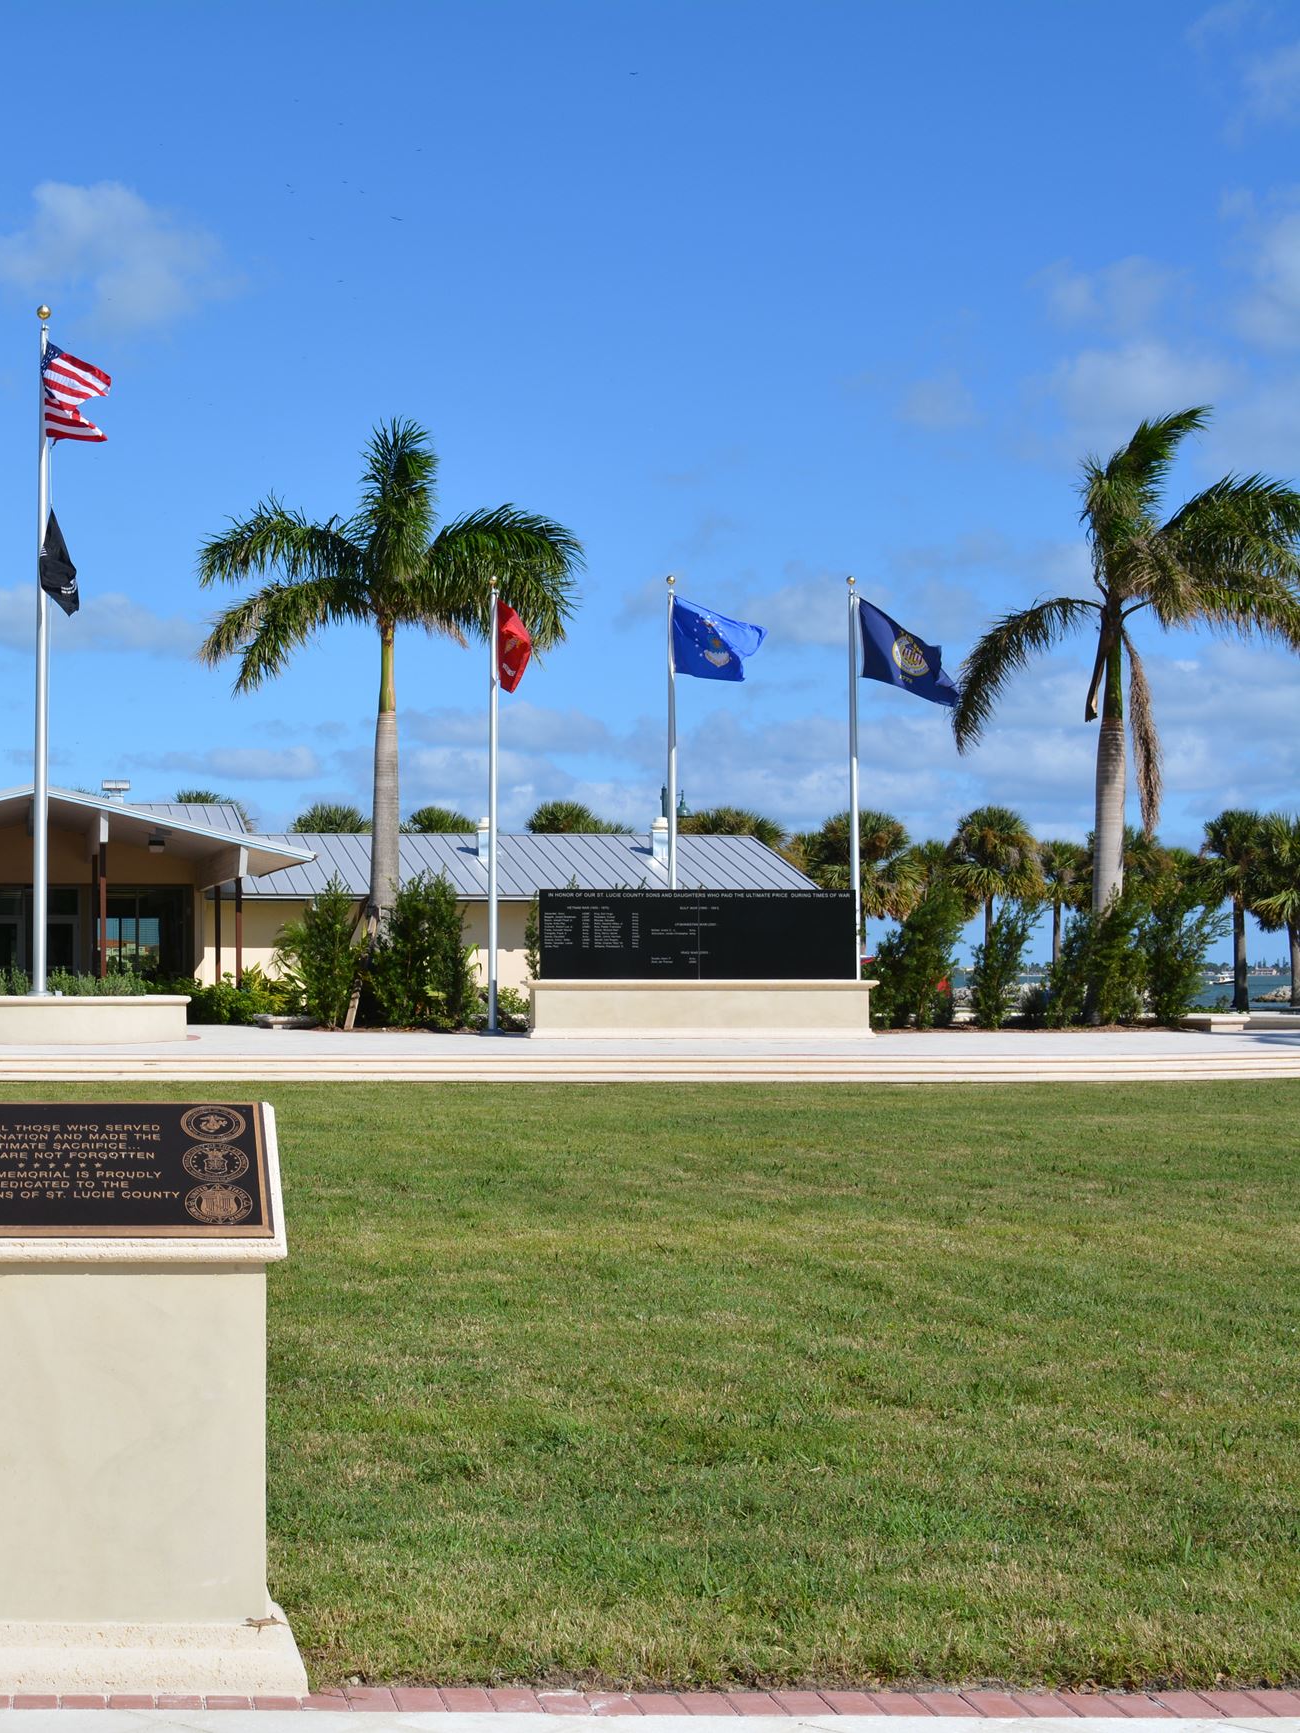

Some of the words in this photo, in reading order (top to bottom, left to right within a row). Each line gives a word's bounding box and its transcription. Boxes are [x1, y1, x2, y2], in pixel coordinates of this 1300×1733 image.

[15, 1124, 60, 1132] THOSE
[67, 1124, 98, 1132] WHO
[106, 1124, 160, 1132] SERVED
[54, 1133, 82, 1141] AND
[89, 1133, 127, 1141] MADE
[134, 1133, 160, 1141] THE
[53, 1142, 140, 1150] SACRIFICE...
[0, 1151, 27, 1159] ARE
[35, 1151, 62, 1159] NOT
[70, 1151, 155, 1159] FORGOTTEN
[77, 1171, 89, 1179] IS
[97, 1171, 161, 1179] PROUDLY
[21, 1191, 39, 1199] OF
[46, 1191, 66, 1199] ST.
[74, 1191, 114, 1199] LUCIE
[122, 1191, 179, 1199] COUNTY
